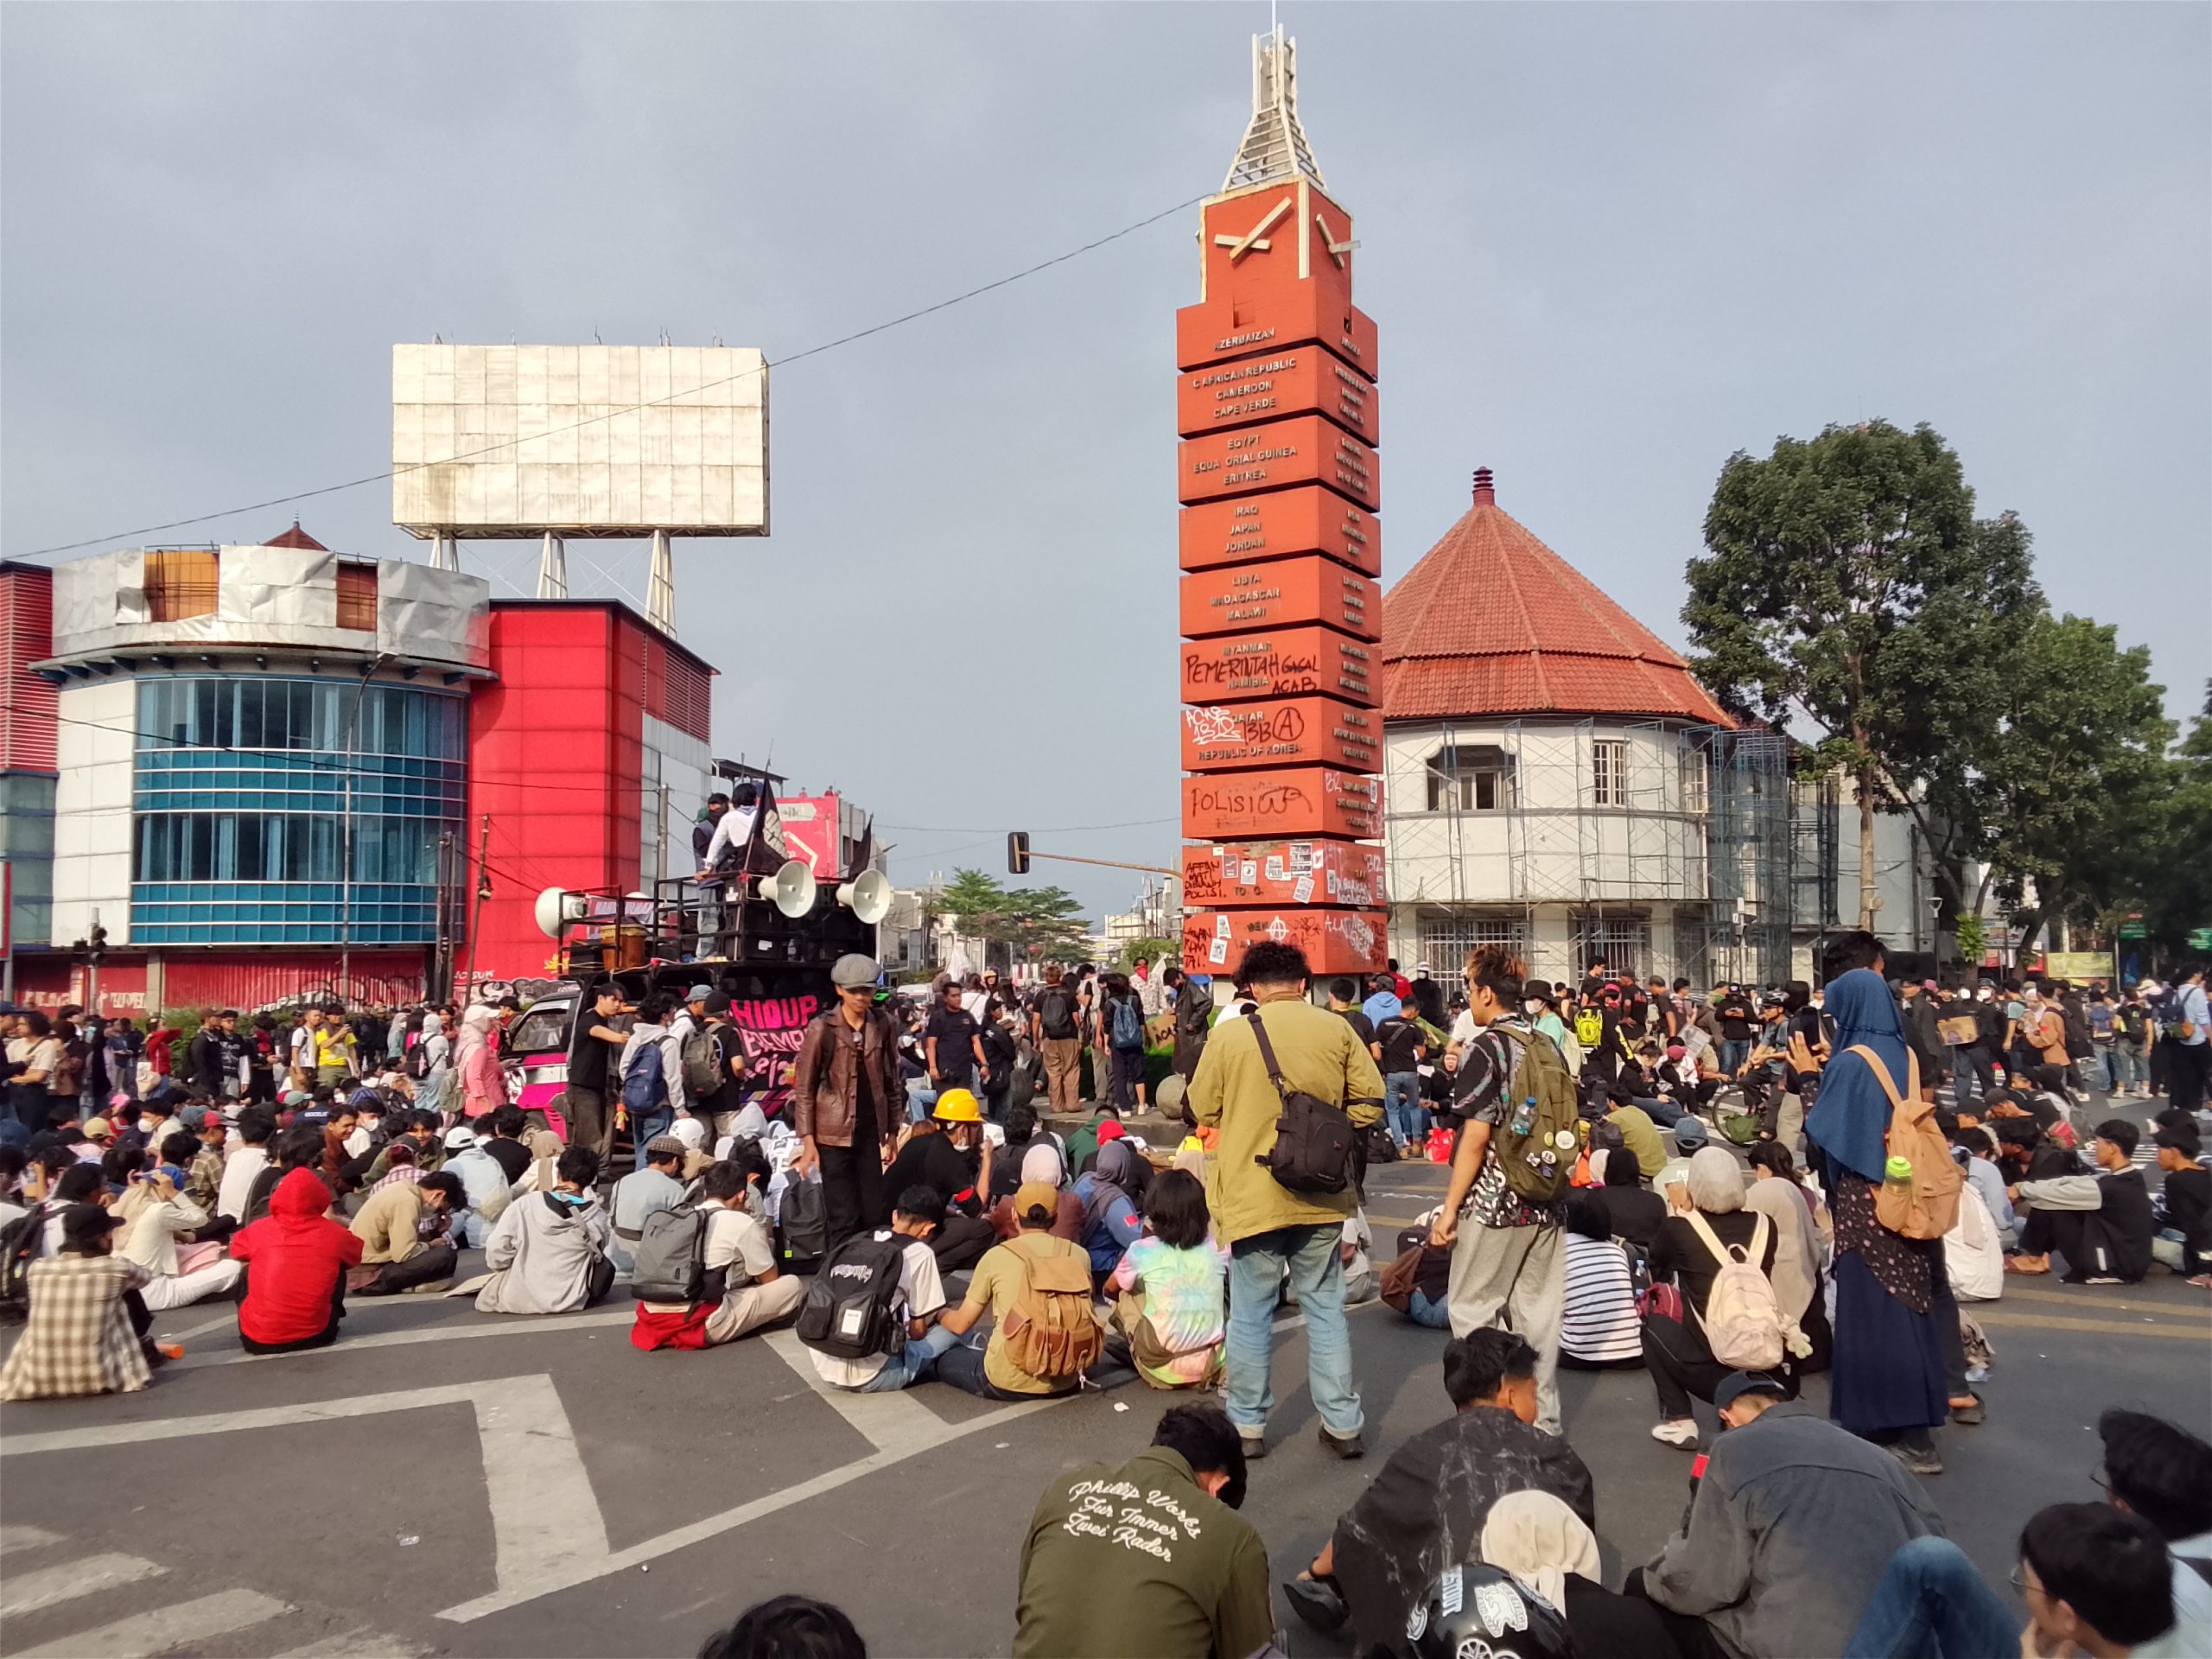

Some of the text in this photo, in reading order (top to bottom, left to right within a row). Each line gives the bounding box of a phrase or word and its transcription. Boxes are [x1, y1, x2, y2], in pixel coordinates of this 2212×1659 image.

[1193, 358, 1296, 388] C AFRICAN REPUBLIC
[1216, 380, 1273, 400] CAMEROON
[1213, 397, 1276, 418] CAPE VERDE
[1227, 435, 1261, 449] EGYPT
[1258, 446, 1297, 461] GUINEA
[1230, 523, 1262, 536] JAPAN
[1224, 539, 1265, 553] JORDAN
[1232, 574, 1261, 587] LIBYA
[1227, 607, 1266, 621] MALAWI
[1186, 652, 1279, 683] PEMERINTAH
[1273, 677, 1317, 694] ACAB
[730, 995, 818, 1029] HIDUP
[1069, 1479, 1202, 1540] Phillip Works
[1117, 1507, 1178, 1541] Immer
[1063, 1513, 1172, 1563] Zwei Rader
